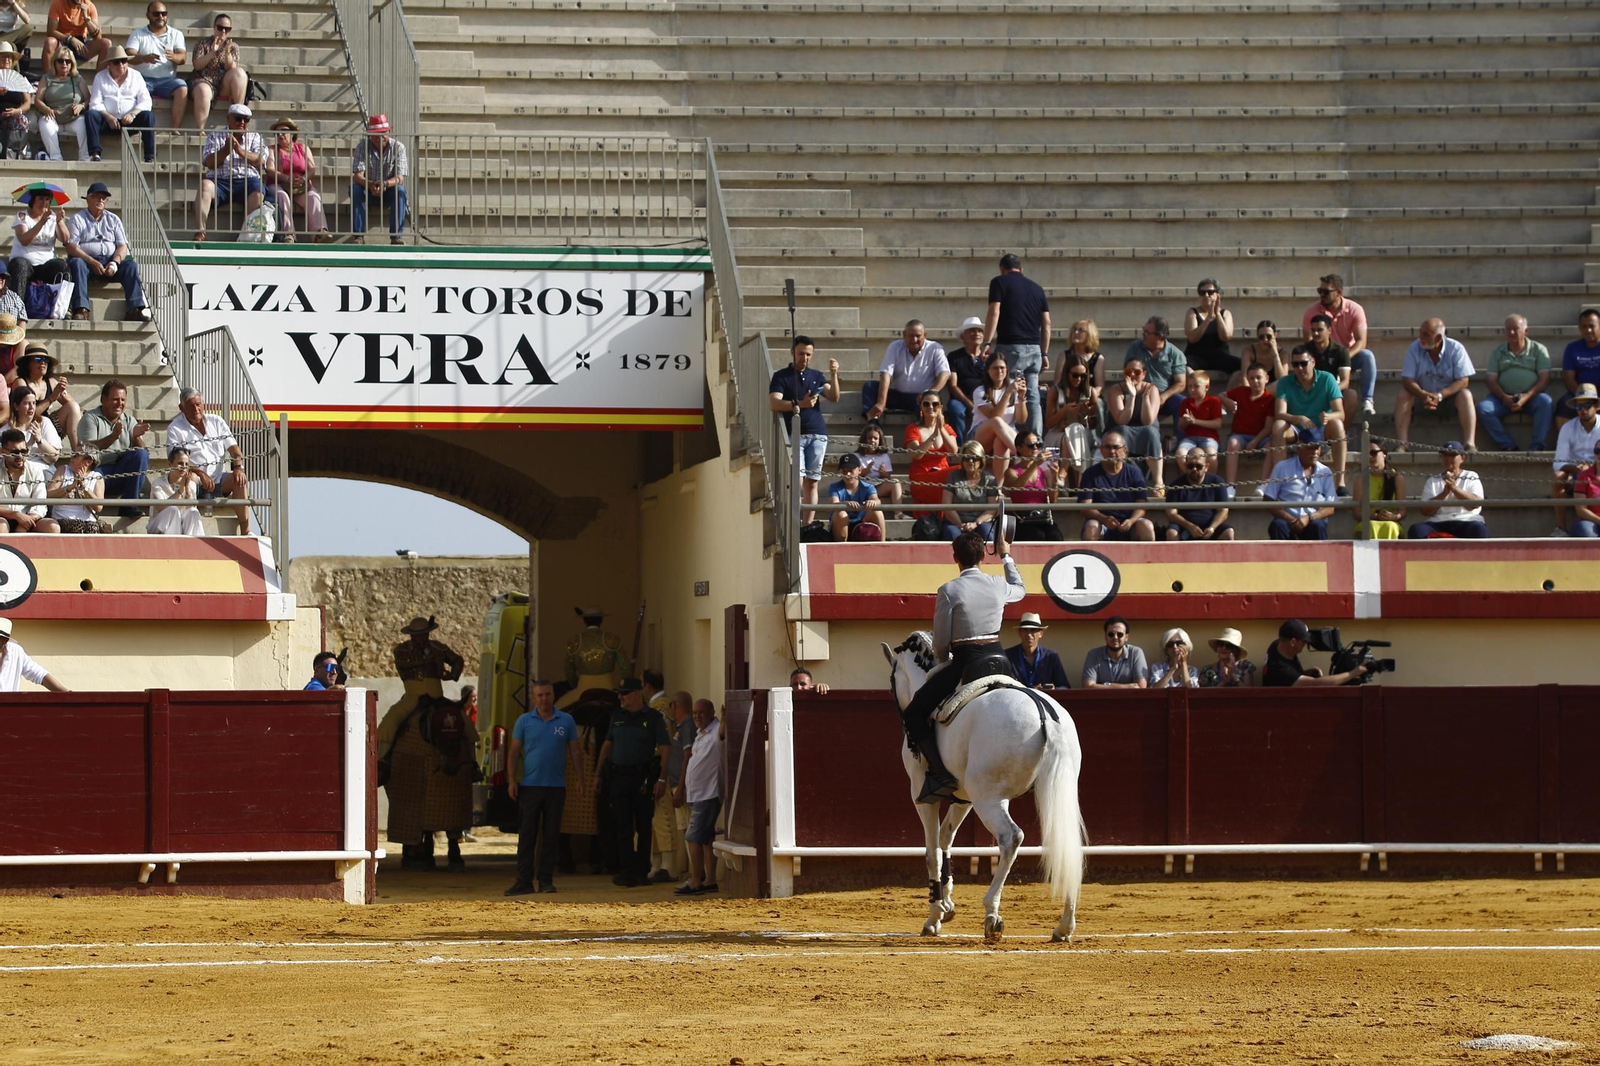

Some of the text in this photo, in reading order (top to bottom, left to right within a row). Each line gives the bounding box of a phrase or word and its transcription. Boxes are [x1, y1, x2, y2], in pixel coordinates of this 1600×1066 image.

[337, 286, 406, 314] DE
[424, 286, 604, 316] TOROS
[623, 289, 692, 318] DE
[284, 331, 560, 386] VERA
[620, 353, 692, 371] 1879
[1073, 566, 1087, 590] 1
